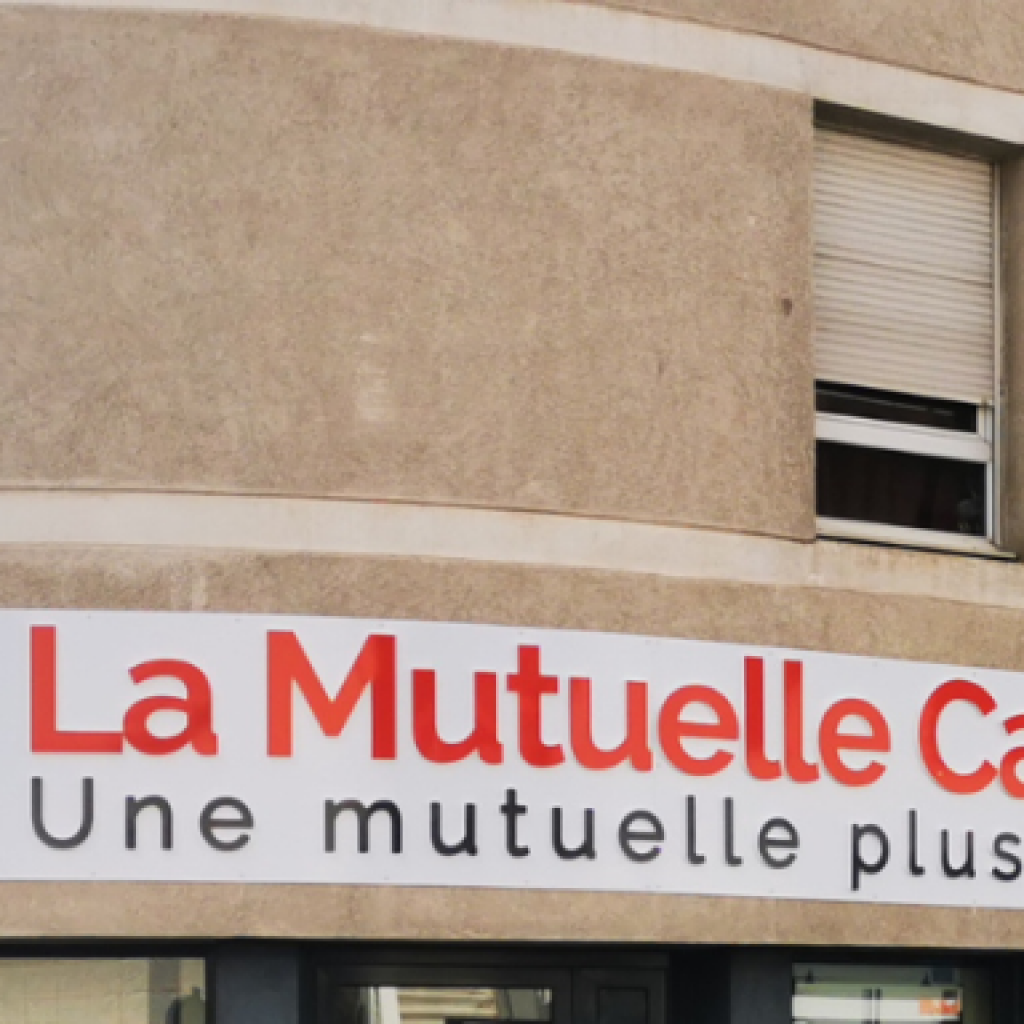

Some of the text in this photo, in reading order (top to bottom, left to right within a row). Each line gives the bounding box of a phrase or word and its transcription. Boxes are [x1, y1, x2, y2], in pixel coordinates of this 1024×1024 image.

[30, 625, 219, 757] La
[266, 630, 892, 788] Mutuelle
[31, 777, 254, 852] Une
[324, 788, 799, 870] mutuelle
[850, 810, 1023, 892] plus
